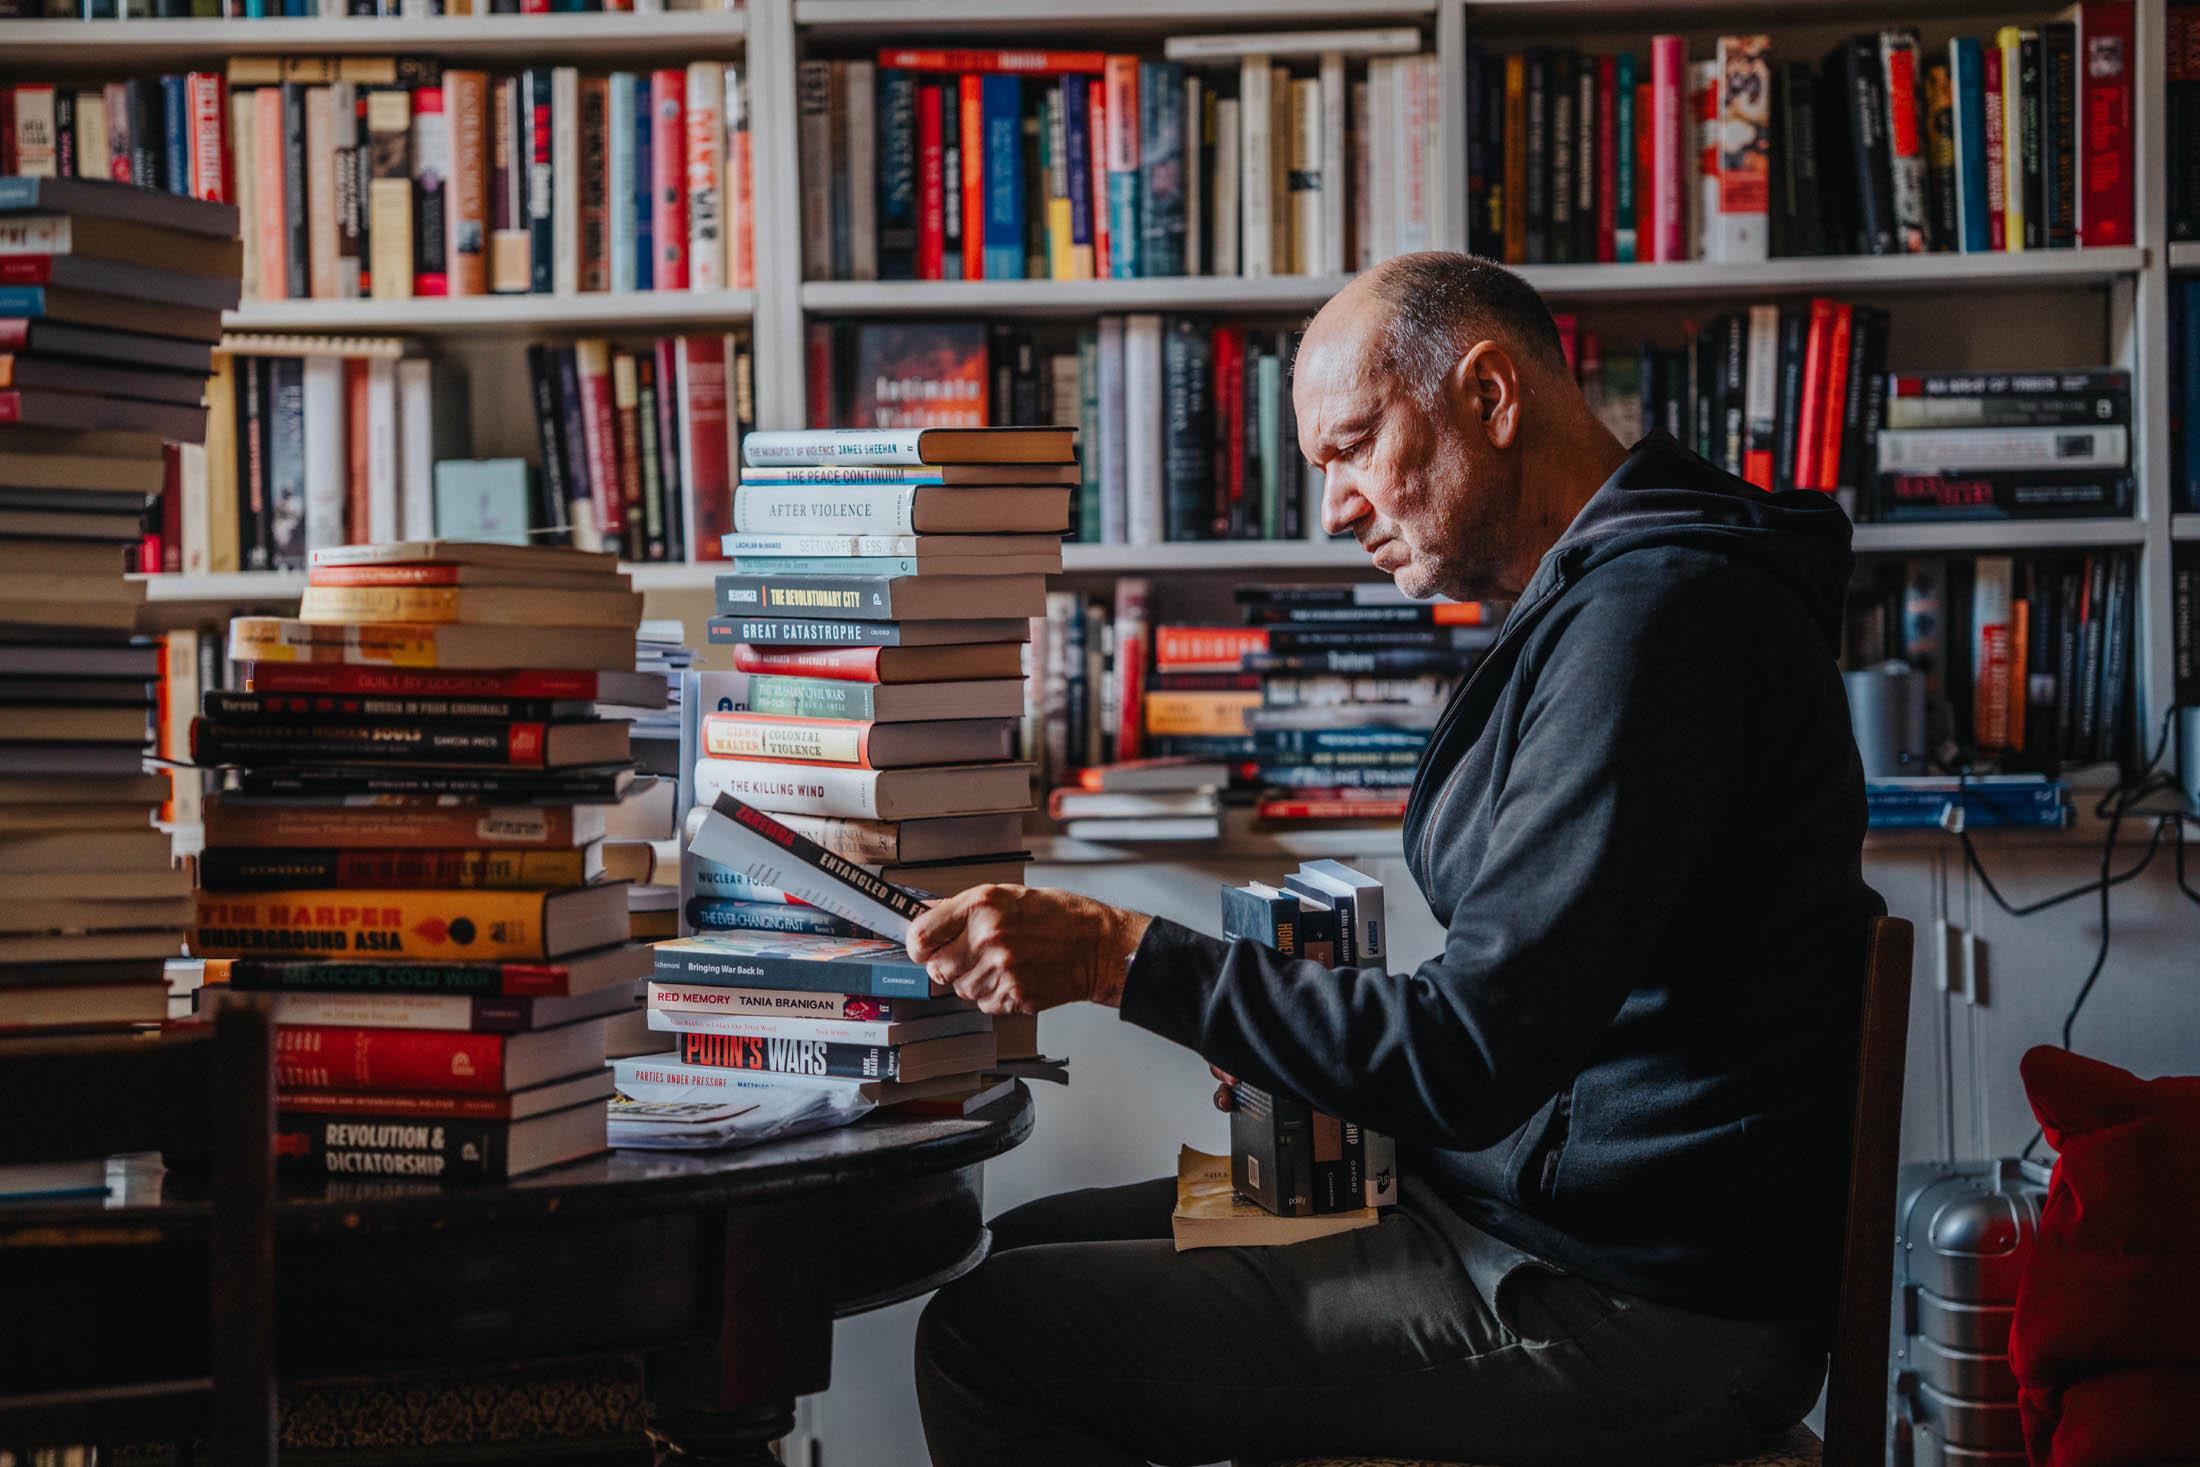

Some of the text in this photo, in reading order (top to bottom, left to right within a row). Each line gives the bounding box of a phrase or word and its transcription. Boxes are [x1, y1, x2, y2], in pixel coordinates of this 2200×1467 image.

[875, 376, 980, 402] Intimate
[763, 447, 797, 457] MONOPOLY
[797, 447, 804, 456] OF
[806, 445, 835, 456] VIOLENCE
[837, 443, 897, 455] JAMES SHEEHAN
[786, 469, 905, 484] THE PEACE CONTINUUM
[769, 503, 872, 517] AFTER VIOLENCE
[799, 540, 839, 553] SETTLING
[770, 588, 860, 608] THE REVOLUTIONARY CITY
[742, 623, 862, 640] GREAT CATASTROPHE
[759, 683, 772, 697] THE
[805, 686, 825, 700] CIVIL
[825, 688, 846, 701] WARS
[768, 728, 820, 743] COLONIAL
[715, 739, 760, 752] WALTER
[769, 742, 822, 757] VIOLENCE
[731, 780, 825, 798] THE KILLING WIND
[698, 872, 743, 885] NUCLEAR
[819, 853, 889, 899] ENTANGLED
[890, 893, 908, 910] IN
[199, 905, 404, 928] TIM HARPER
[700, 911, 805, 931] THE EVER-CHANGING PAST
[198, 928, 404, 952] UNDERGROUND ASIA
[282, 965, 490, 987] MEXICO'S COLD WAR
[687, 962, 765, 977] Bringing War Back In
[657, 992, 731, 1005] RED MEMORY
[739, 995, 834, 1010] TANIA BRANIGAN
[686, 1032, 828, 1077] PUTIN'S WARS
[870, 1048, 879, 1076] GALEOTTI
[863, 1057, 871, 1076] MARK
[635, 1070, 664, 1083] PARTIES
[666, 1074, 689, 1086] UNDER
[326, 1123, 429, 1149] REVOLUTION
[431, 1126, 446, 1149] &
[326, 1151, 445, 1175] DICTATORSHIP
[1350, 1160, 1358, 1193] OXFORD
